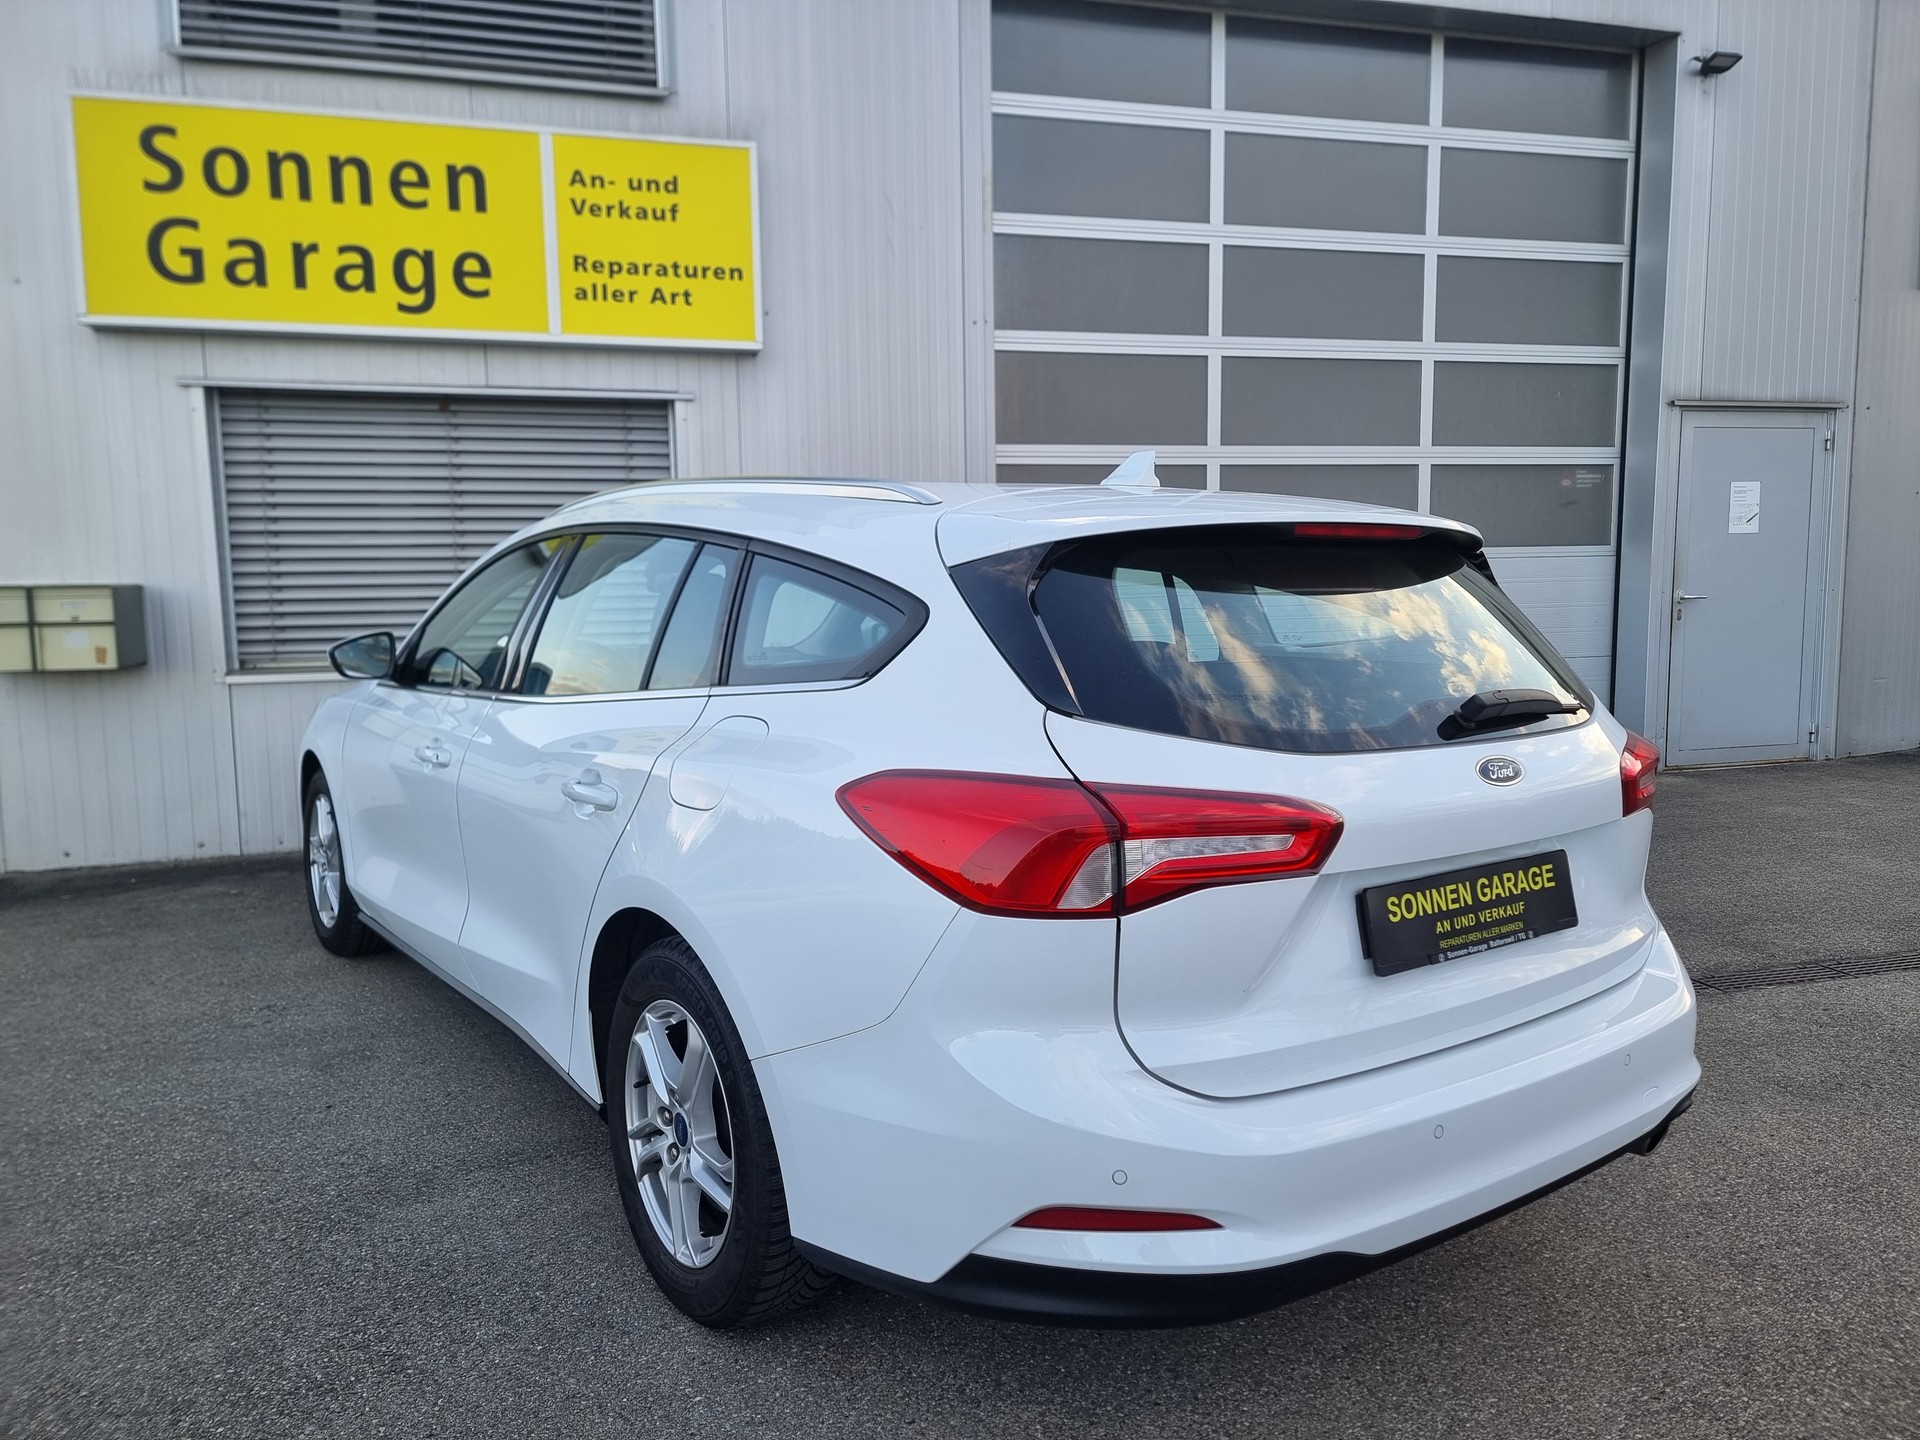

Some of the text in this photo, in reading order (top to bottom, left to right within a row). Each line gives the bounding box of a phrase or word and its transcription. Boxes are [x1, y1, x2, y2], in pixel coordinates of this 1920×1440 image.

[137, 123, 489, 215] Sonnen
[569, 169, 679, 194] An- und
[569, 197, 680, 223] Verkauf
[146, 216, 493, 315] Garage
[573, 255, 744, 281] Reparaturen
[574, 283, 693, 306] aller Art
[1488, 761, 1514, 779] Ford
[1387, 863, 1556, 923] SONNEN GARAGE
[1435, 901, 1526, 934] AN UND VERKAUF
[1439, 921, 1524, 949] REPARATUREN ALLER MARKEN
[1447, 943, 1489, 959] Sonnen-Garage
